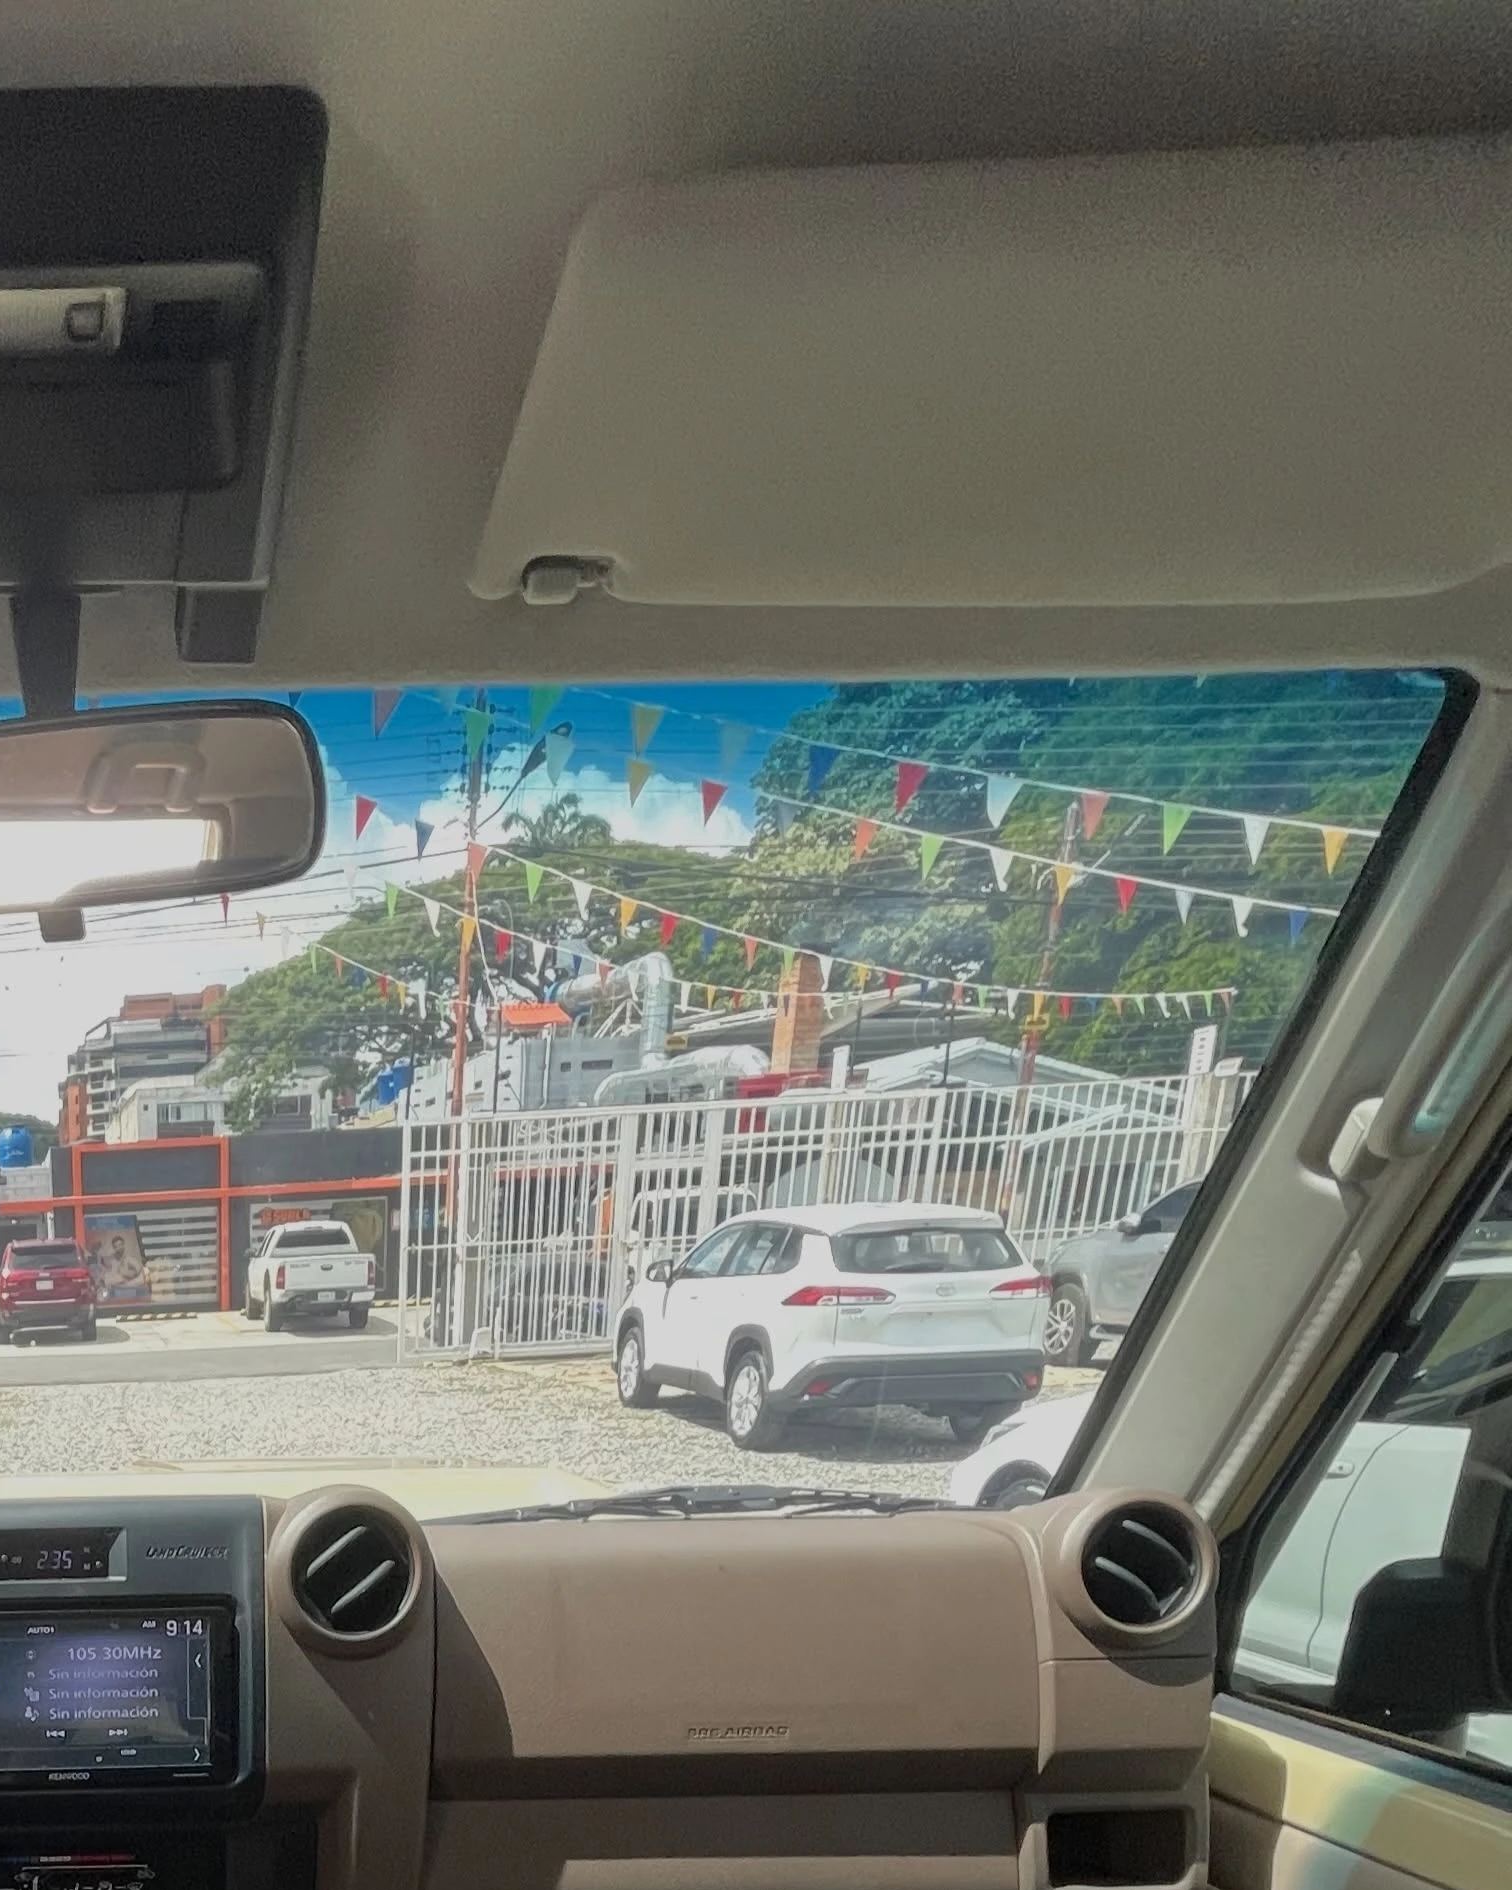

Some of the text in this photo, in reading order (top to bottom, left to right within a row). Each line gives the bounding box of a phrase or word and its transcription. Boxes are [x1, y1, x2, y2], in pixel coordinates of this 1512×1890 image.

[142, 1620, 157, 1629] AM
[67, 1645, 162, 1662] 10530MHz
[48, 1666, 159, 1680] Sin información
[48, 1685, 159, 1700] Sin información
[49, 1704, 159, 1720] Sin información
[48, 1771, 90, 1781] KENWOOD
